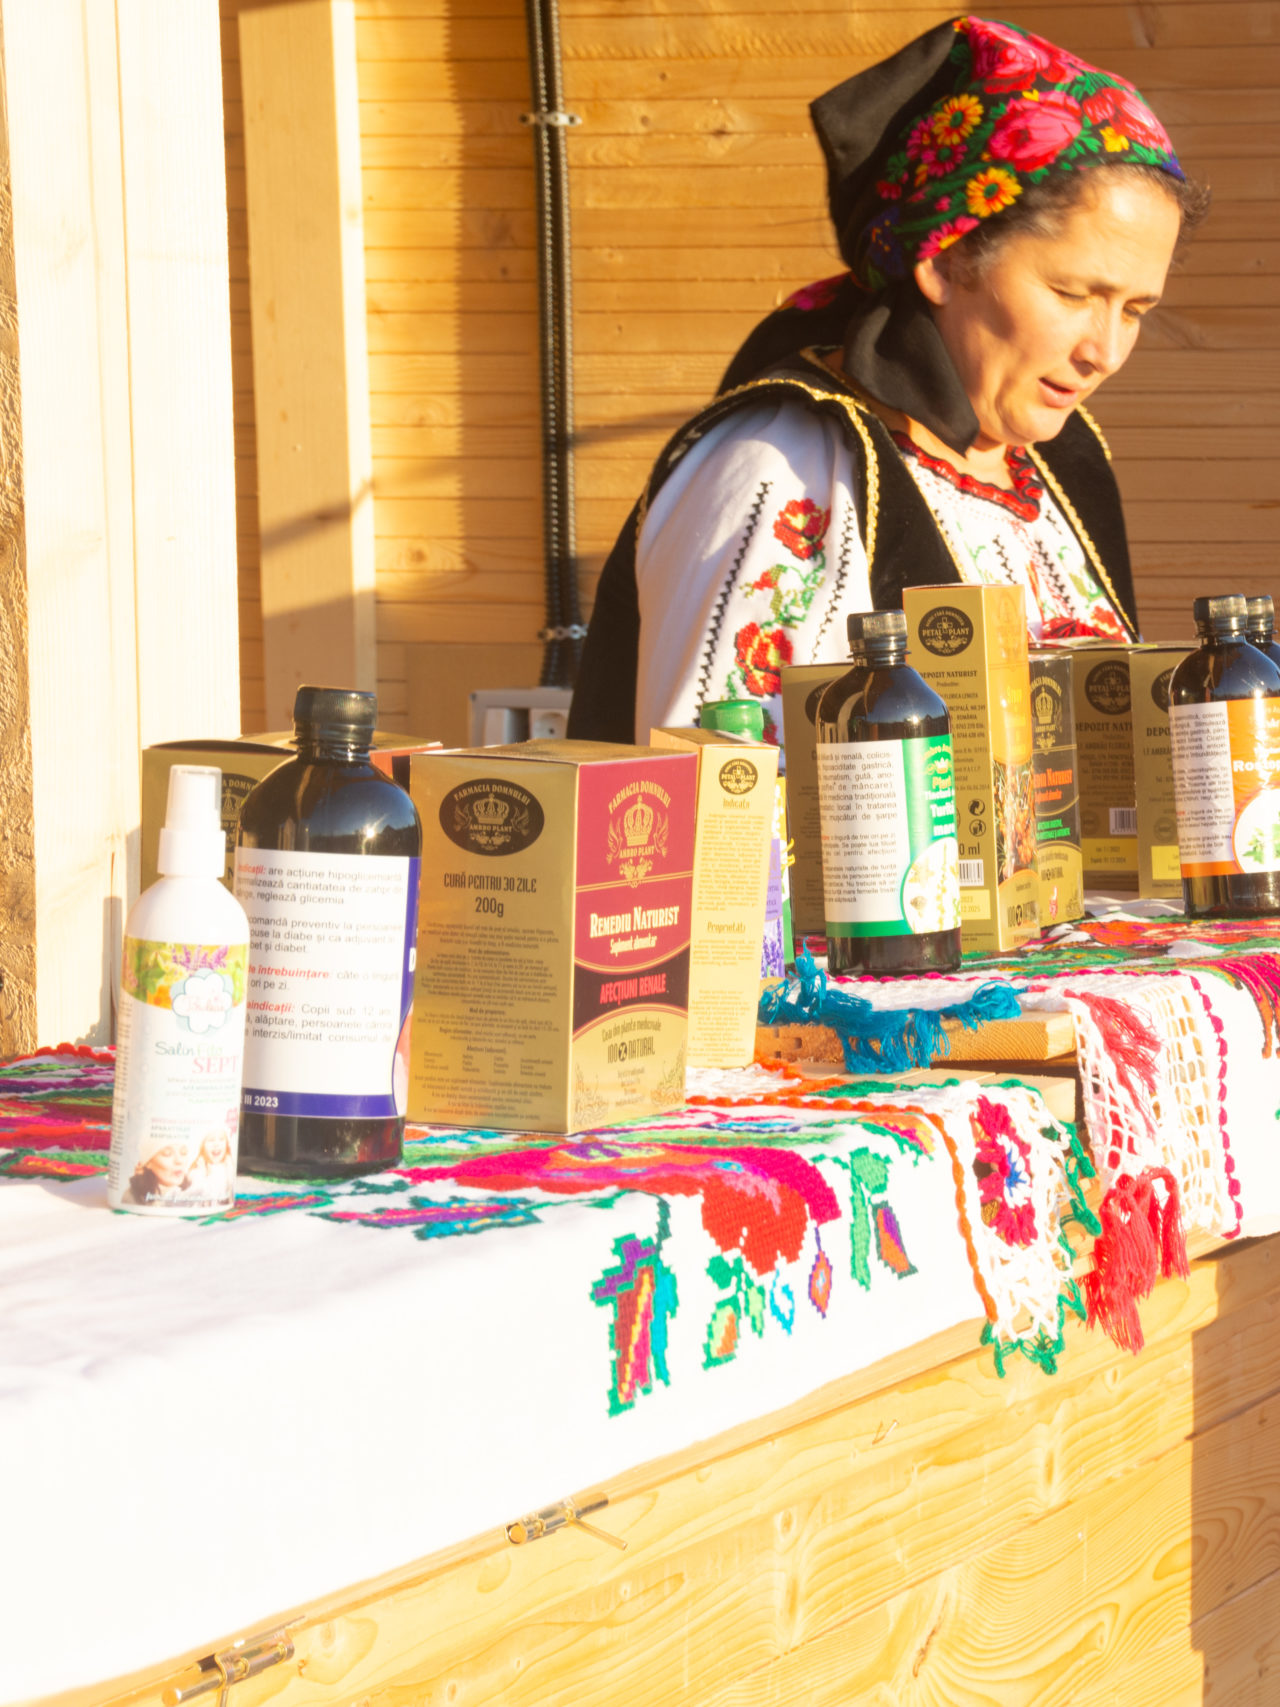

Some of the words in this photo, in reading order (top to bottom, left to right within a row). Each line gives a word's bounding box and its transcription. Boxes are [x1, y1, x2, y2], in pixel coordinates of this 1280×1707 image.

[922, 629, 941, 637] PETAL
[948, 627, 970, 636] PLANT
[946, 670, 977, 678] NATURIST
[1116, 683, 1131, 692] PLA
[1146, 728, 1171, 737] DEPO
[1046, 768, 1073, 786] NATURIST
[454, 784, 490, 802] FARMACIA
[492, 784, 531, 806] DOMNULUI
[608, 781, 640, 814] FARMACIA
[640, 780, 672, 808] DOMNULUI
[968, 843, 980, 855] ml
[268, 867, 284, 876] are
[286, 868, 325, 880] acțiune
[349, 884, 362, 893] de
[444, 872, 466, 889] CURĂ
[468, 874, 502, 891] PENTRU
[504, 877, 515, 891] 30
[517, 878, 537, 893] ZILE
[256, 889, 296, 902] reglează
[299, 894, 344, 905] glicemia
[475, 897, 504, 918] 200g
[290, 919, 340, 931] preventiv
[343, 921, 353, 930] la
[590, 912, 631, 938] REMEDIU
[633, 905, 680, 931] NATURIST
[272, 930, 281, 938] la
[284, 931, 312, 941] diabe
[316, 933, 325, 943] și
[328, 935, 342, 943] ca
[264, 943, 272, 953] și
[336, 969, 361, 980] câte
[250, 978, 262, 988] ori
[263, 980, 275, 991] pe
[639, 973, 667, 997] RENALE
[301, 1003, 330, 1016] Copii
[336, 1006, 357, 1016] sub
[362, 1007, 374, 1017] 12
[254, 1016, 297, 1028] alăptare,
[301, 1018, 363, 1030] persoanele
[252, 1028, 323, 1042] interzis/limitat
[628, 1036, 656, 1061] NATURAL
[192, 1056, 240, 1075] SEPT
[254, 1096, 279, 1108] 2023
